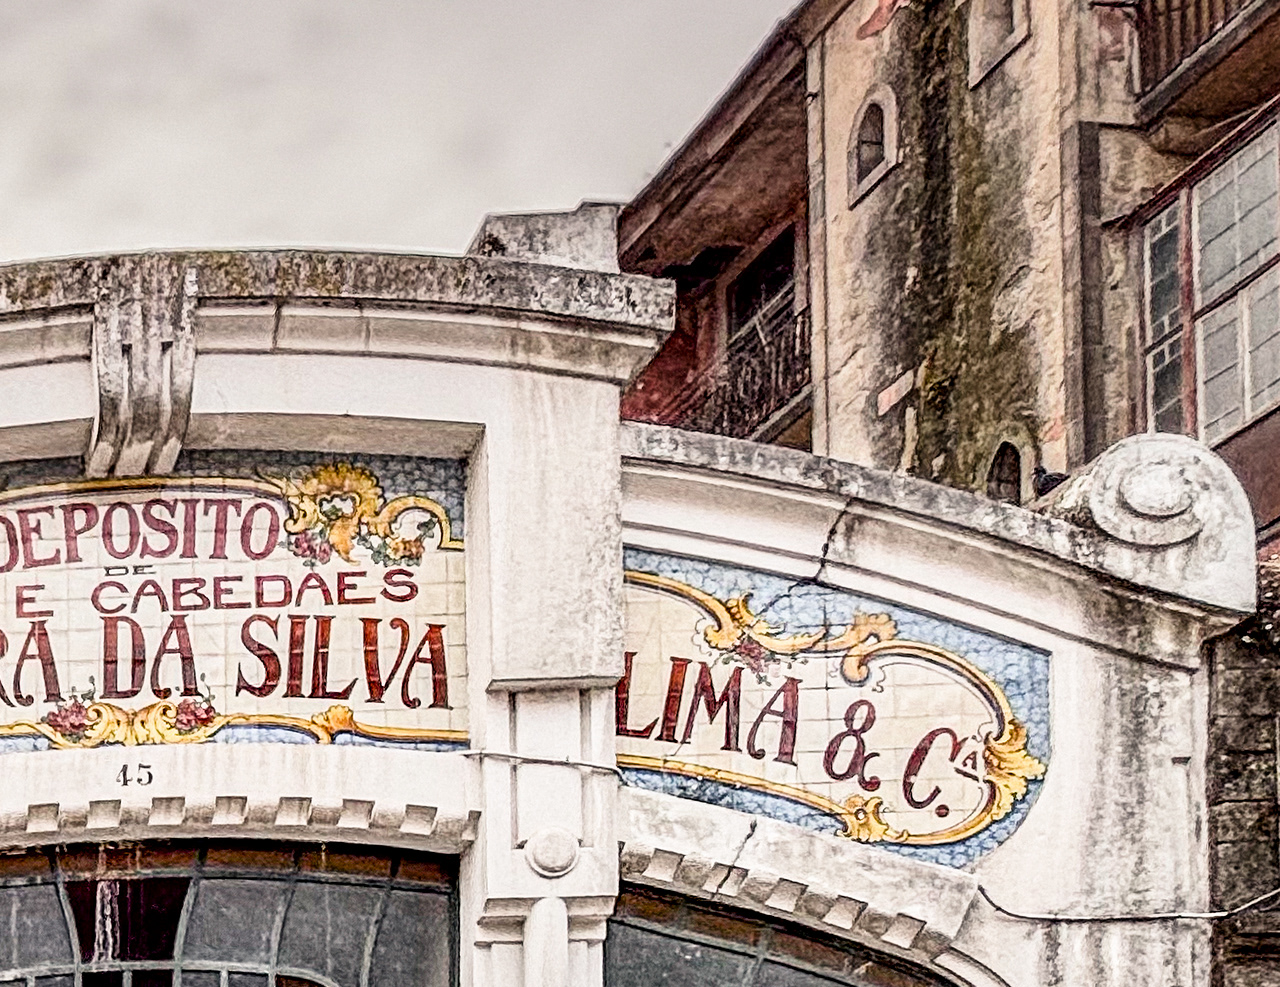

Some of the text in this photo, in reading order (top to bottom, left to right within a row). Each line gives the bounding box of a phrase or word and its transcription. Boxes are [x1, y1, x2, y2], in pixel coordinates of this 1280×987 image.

[16, 584, 54, 618] E
[91, 570, 419, 613] CABEDAES
[104, 564, 157, 576] DE
[99, 614, 204, 701] DA
[236, 614, 454, 710] SILVA
[617, 652, 803, 765] LIMA
[822, 699, 880, 792] &
[116, 763, 153, 786] 45
